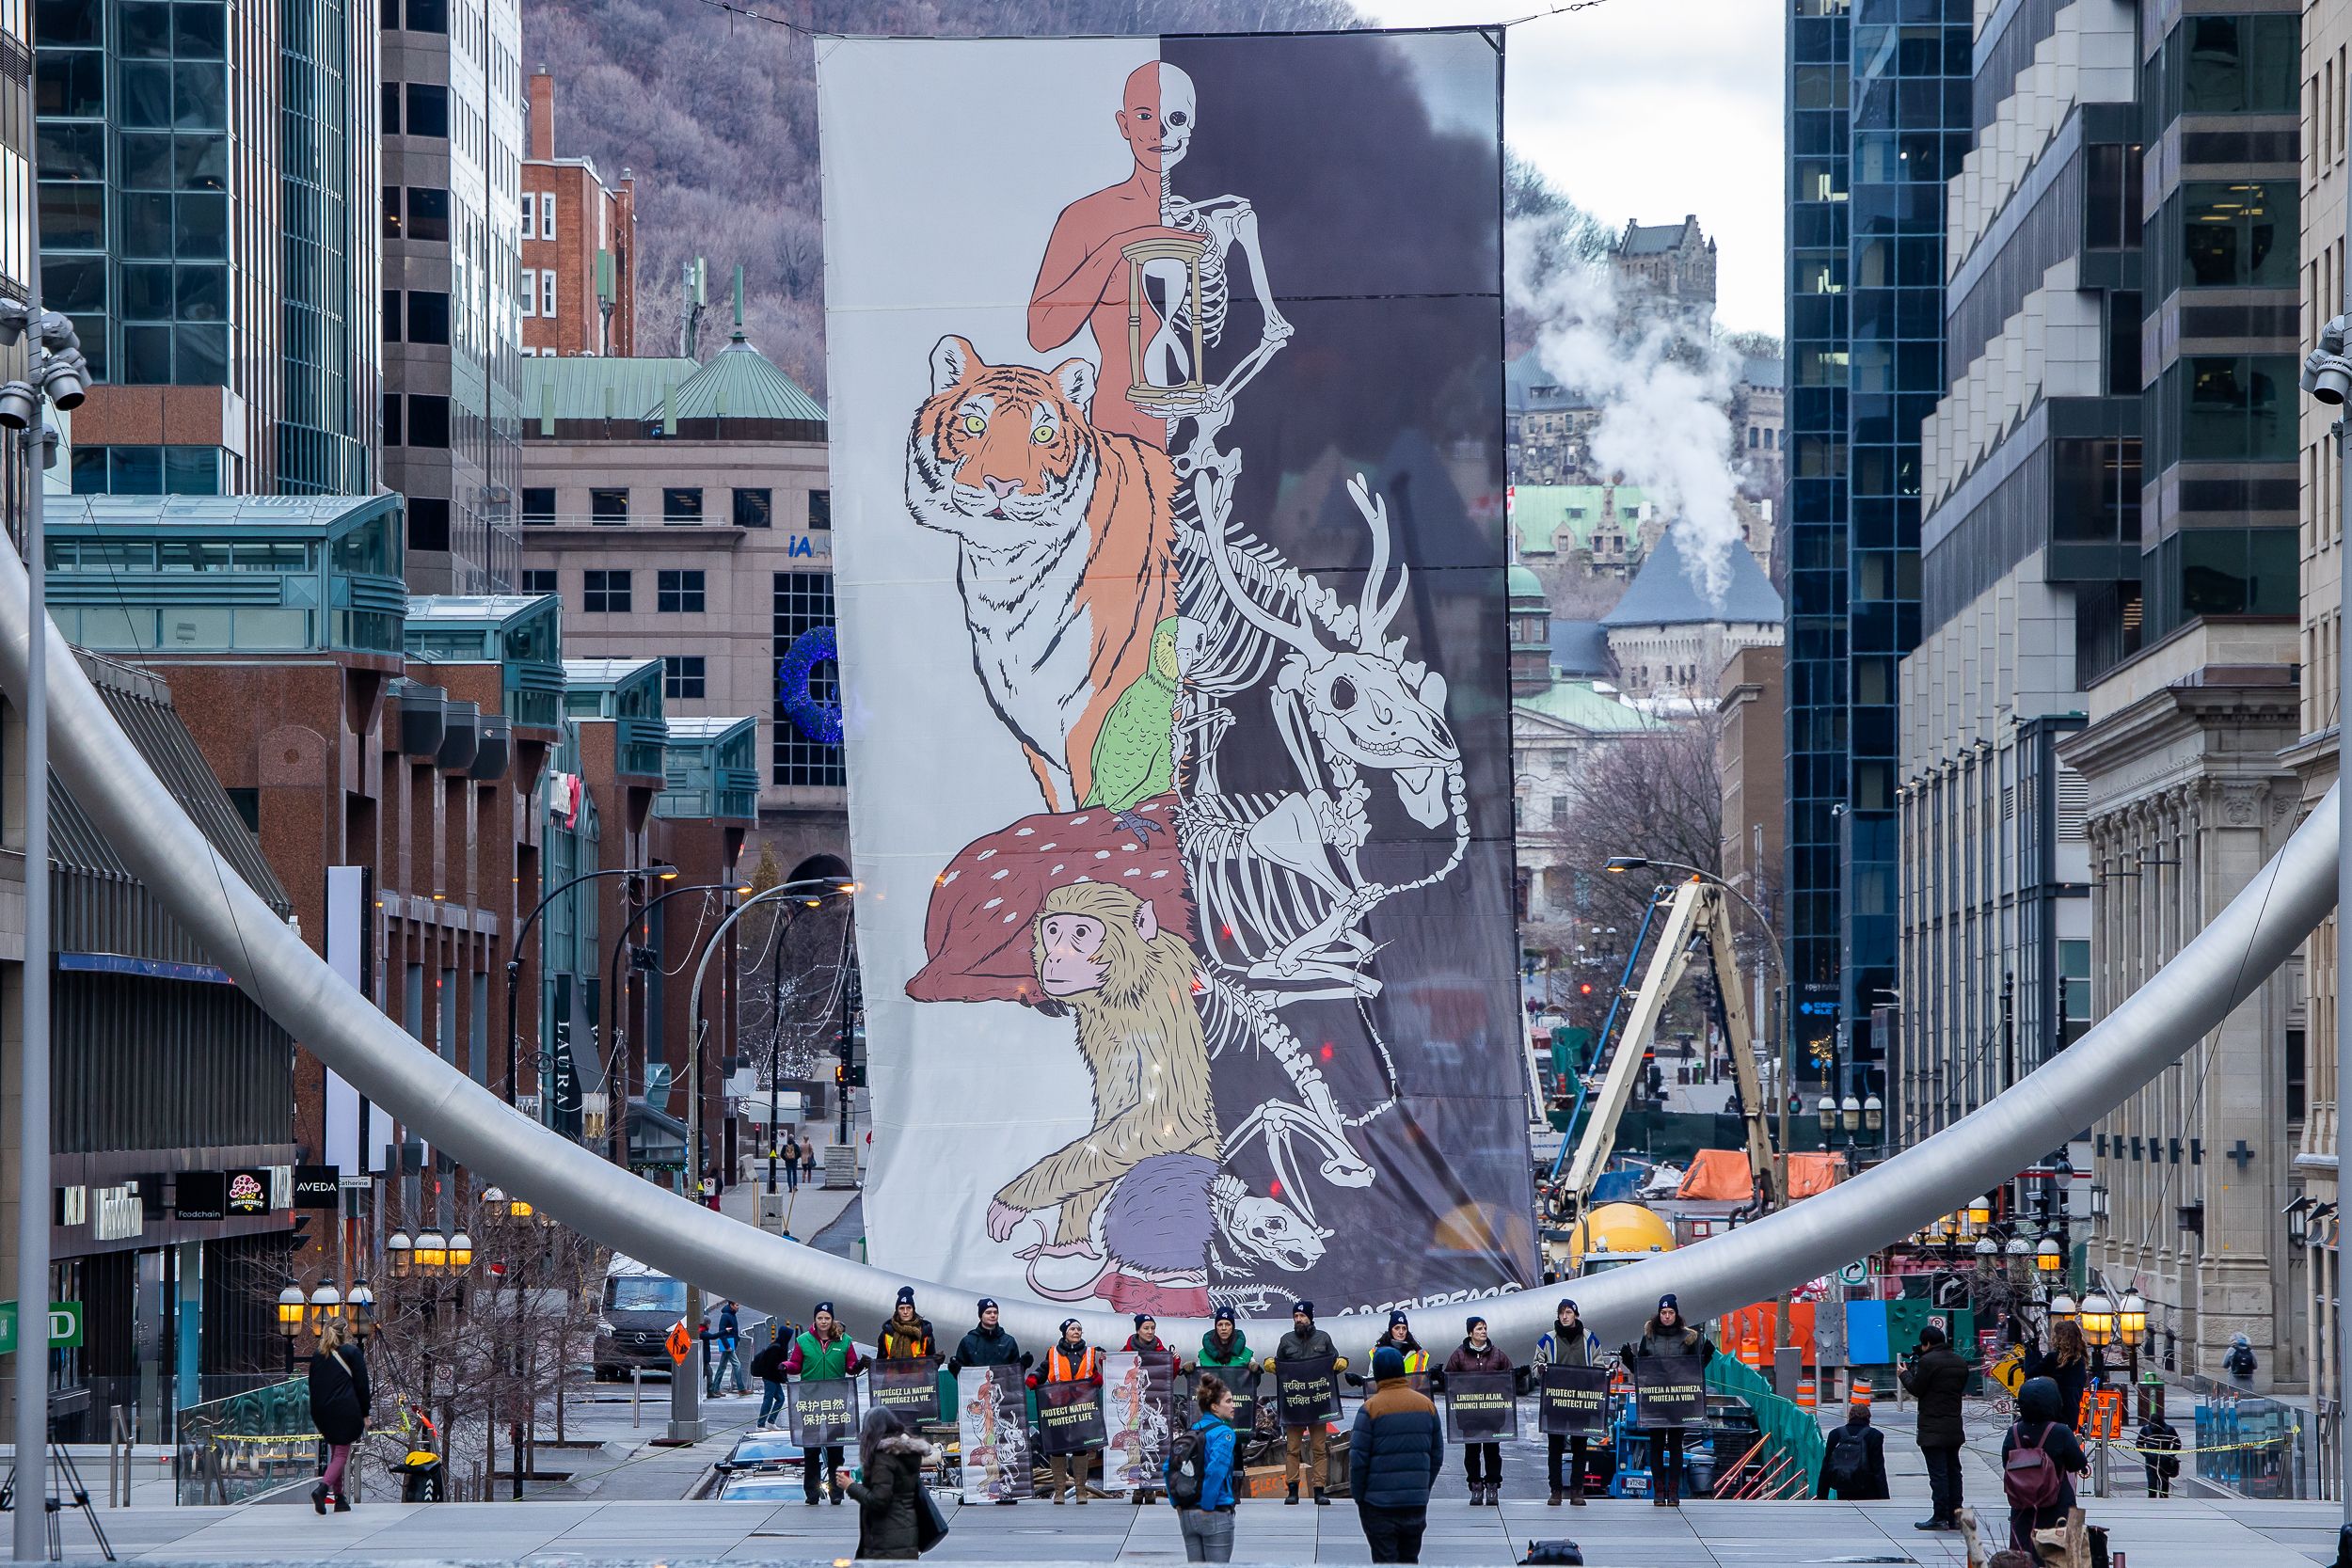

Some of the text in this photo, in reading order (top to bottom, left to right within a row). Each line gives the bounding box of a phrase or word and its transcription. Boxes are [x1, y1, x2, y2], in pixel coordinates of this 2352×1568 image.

[557, 1021, 570, 1105] LAURA
[296, 1182, 337, 1192] AVEDA
[48, 1311, 75, 1338] D
[873, 1387, 902, 1397] PROTÉGEZ
[1456, 1393, 1485, 1402] LINDUNGI
[1546, 1387, 1576, 1398] PROTECT
[795, 1398, 845, 1412] 保护自然
[881, 1396, 911, 1405] PROTÉGEZ
[1450, 1401, 1513, 1410] LINDUNGI KEHIDUPAN
[1552, 1398, 1598, 1410] PROTECT LIFE
[1041, 1406, 1068, 1418] PROTECT
[803, 1411, 851, 1426] 保护生命
[1047, 1412, 1092, 1427] PROTECT LIFE
